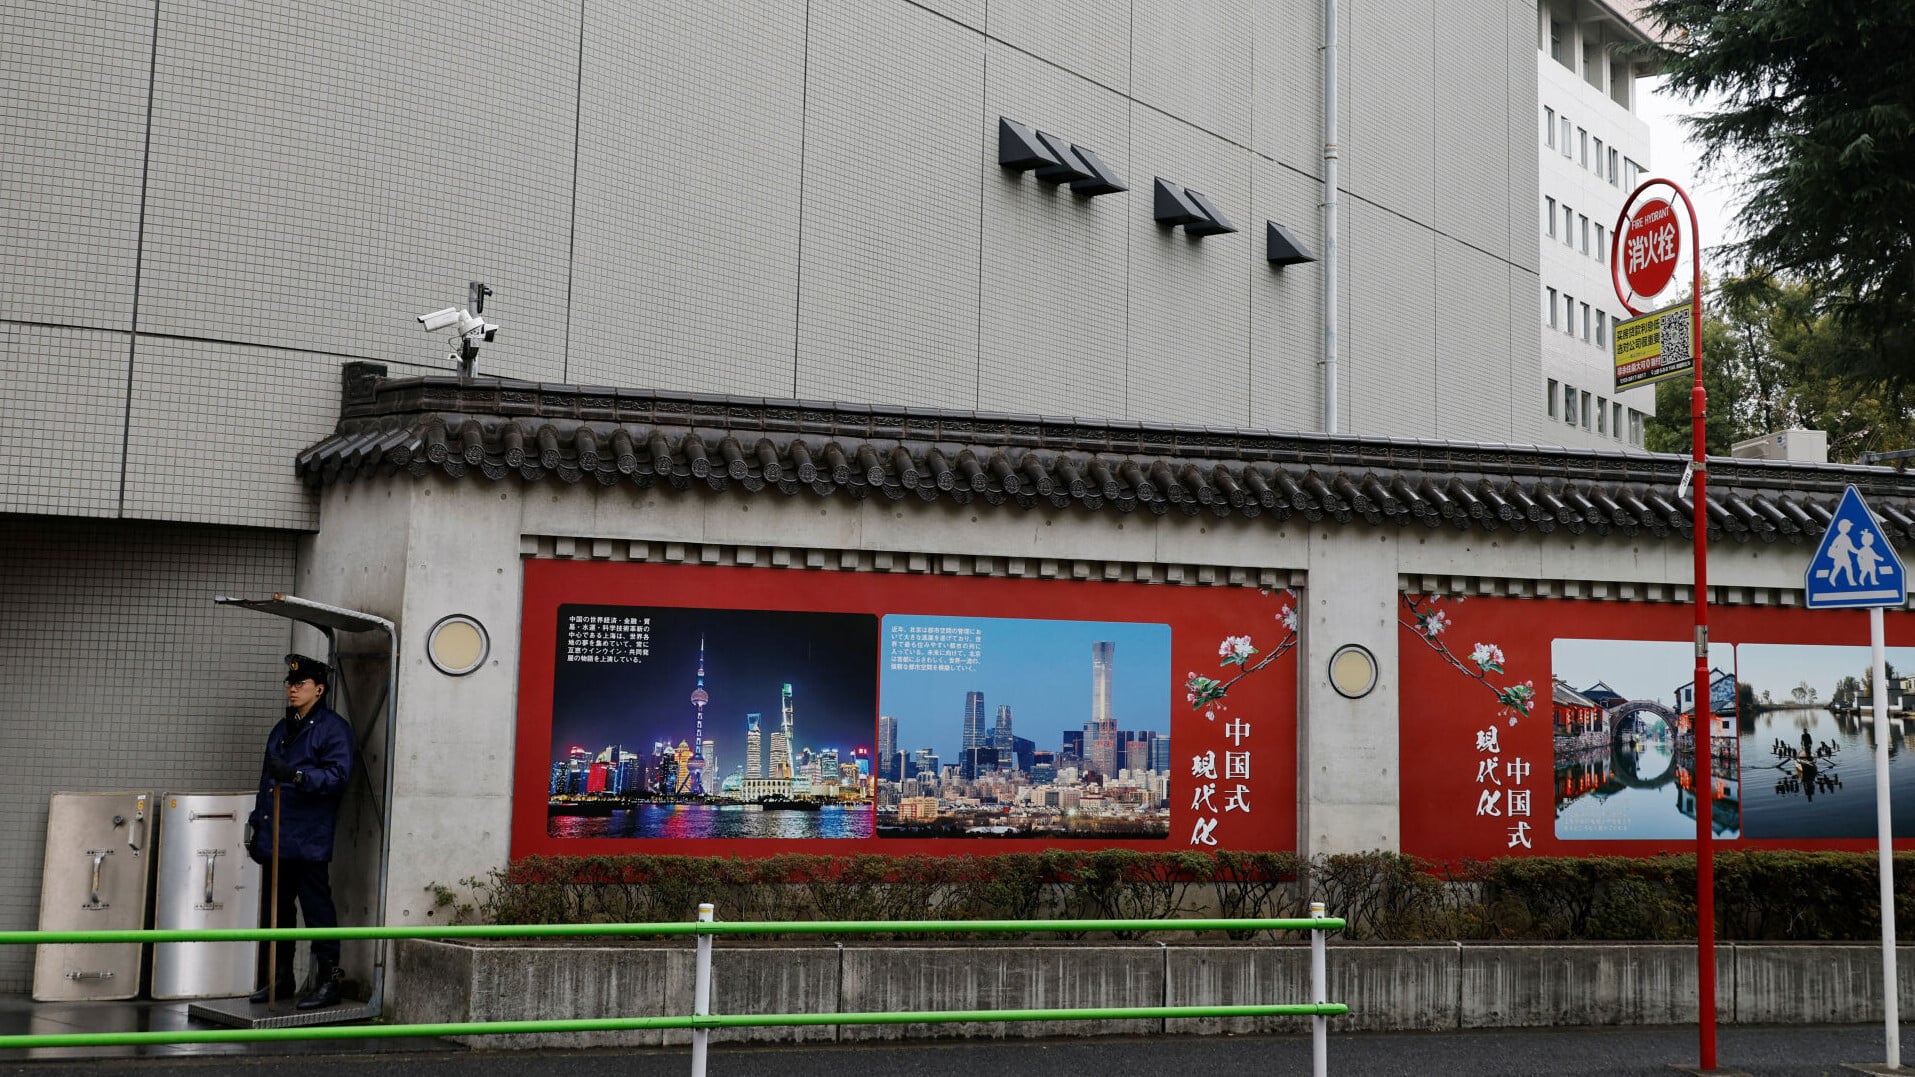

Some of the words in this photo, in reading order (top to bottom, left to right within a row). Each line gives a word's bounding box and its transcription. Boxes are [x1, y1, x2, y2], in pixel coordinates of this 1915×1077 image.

[1628, 222, 1676, 275] 消火栓
[1632, 217, 1644, 231] FIRE
[1645, 206, 1669, 225] HYDRANT
[1190, 750, 1219, 846] 現代化
[1223, 717, 1251, 813] 中国式
[1475, 725, 1502, 817] 現代化
[1506, 757, 1532, 849] 中国式
